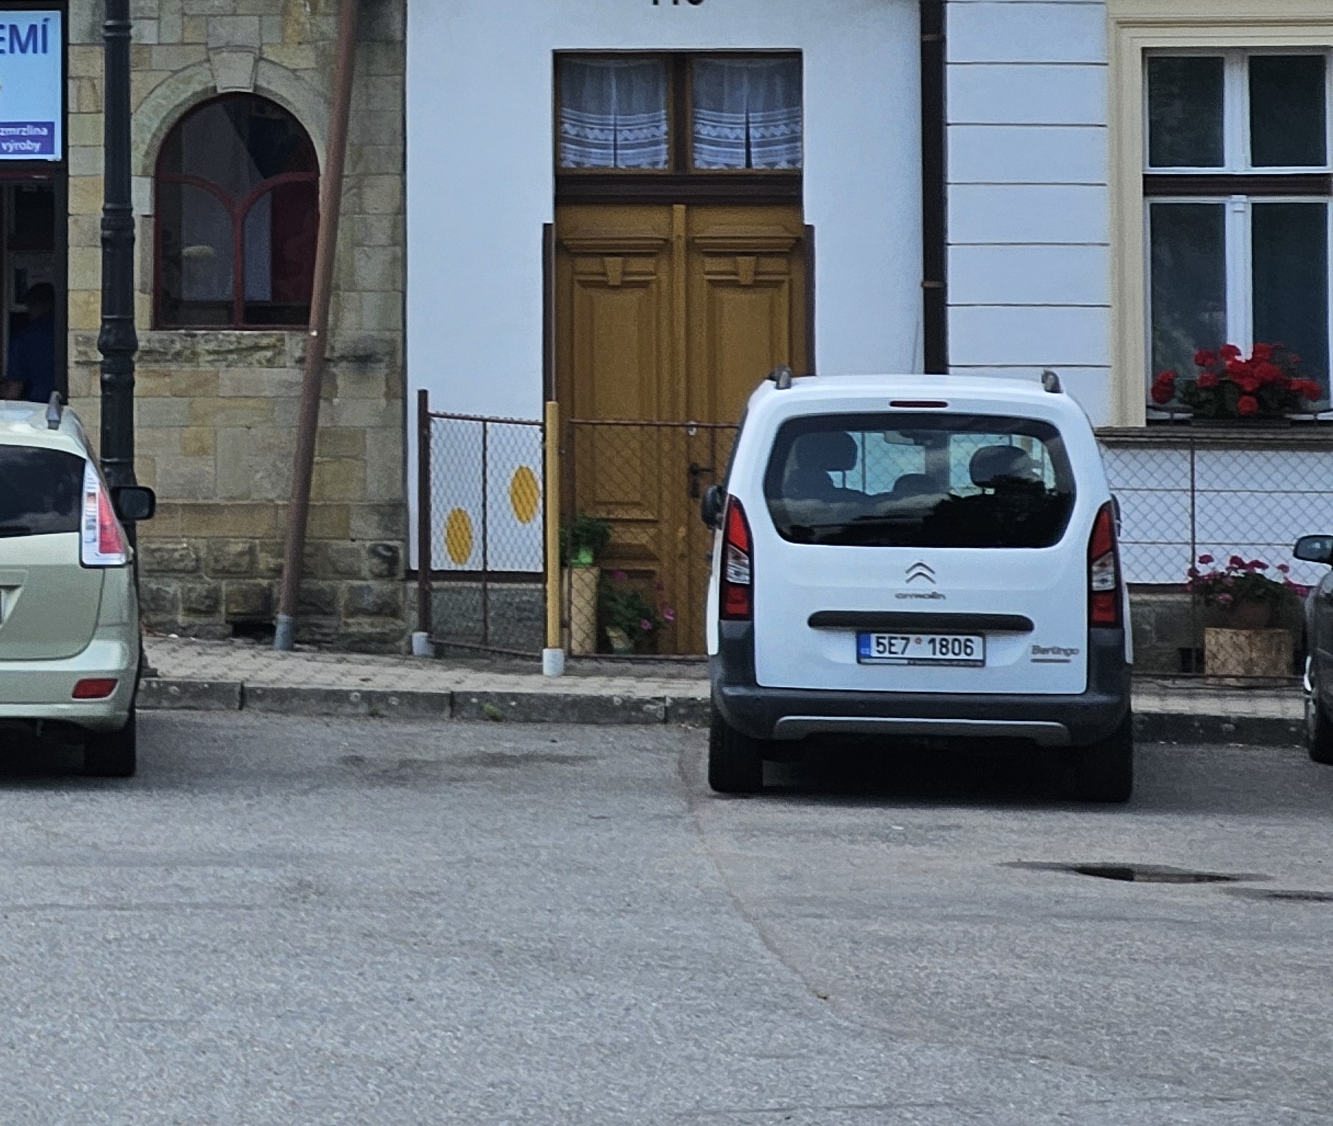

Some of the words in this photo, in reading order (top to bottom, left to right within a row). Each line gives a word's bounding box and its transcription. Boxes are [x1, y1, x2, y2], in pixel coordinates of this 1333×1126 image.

[0, 124, 48, 136] zmrzlina
[1, 139, 41, 152] výroby
[876, 636, 910, 654] 5E7
[928, 637, 974, 656] 1806
